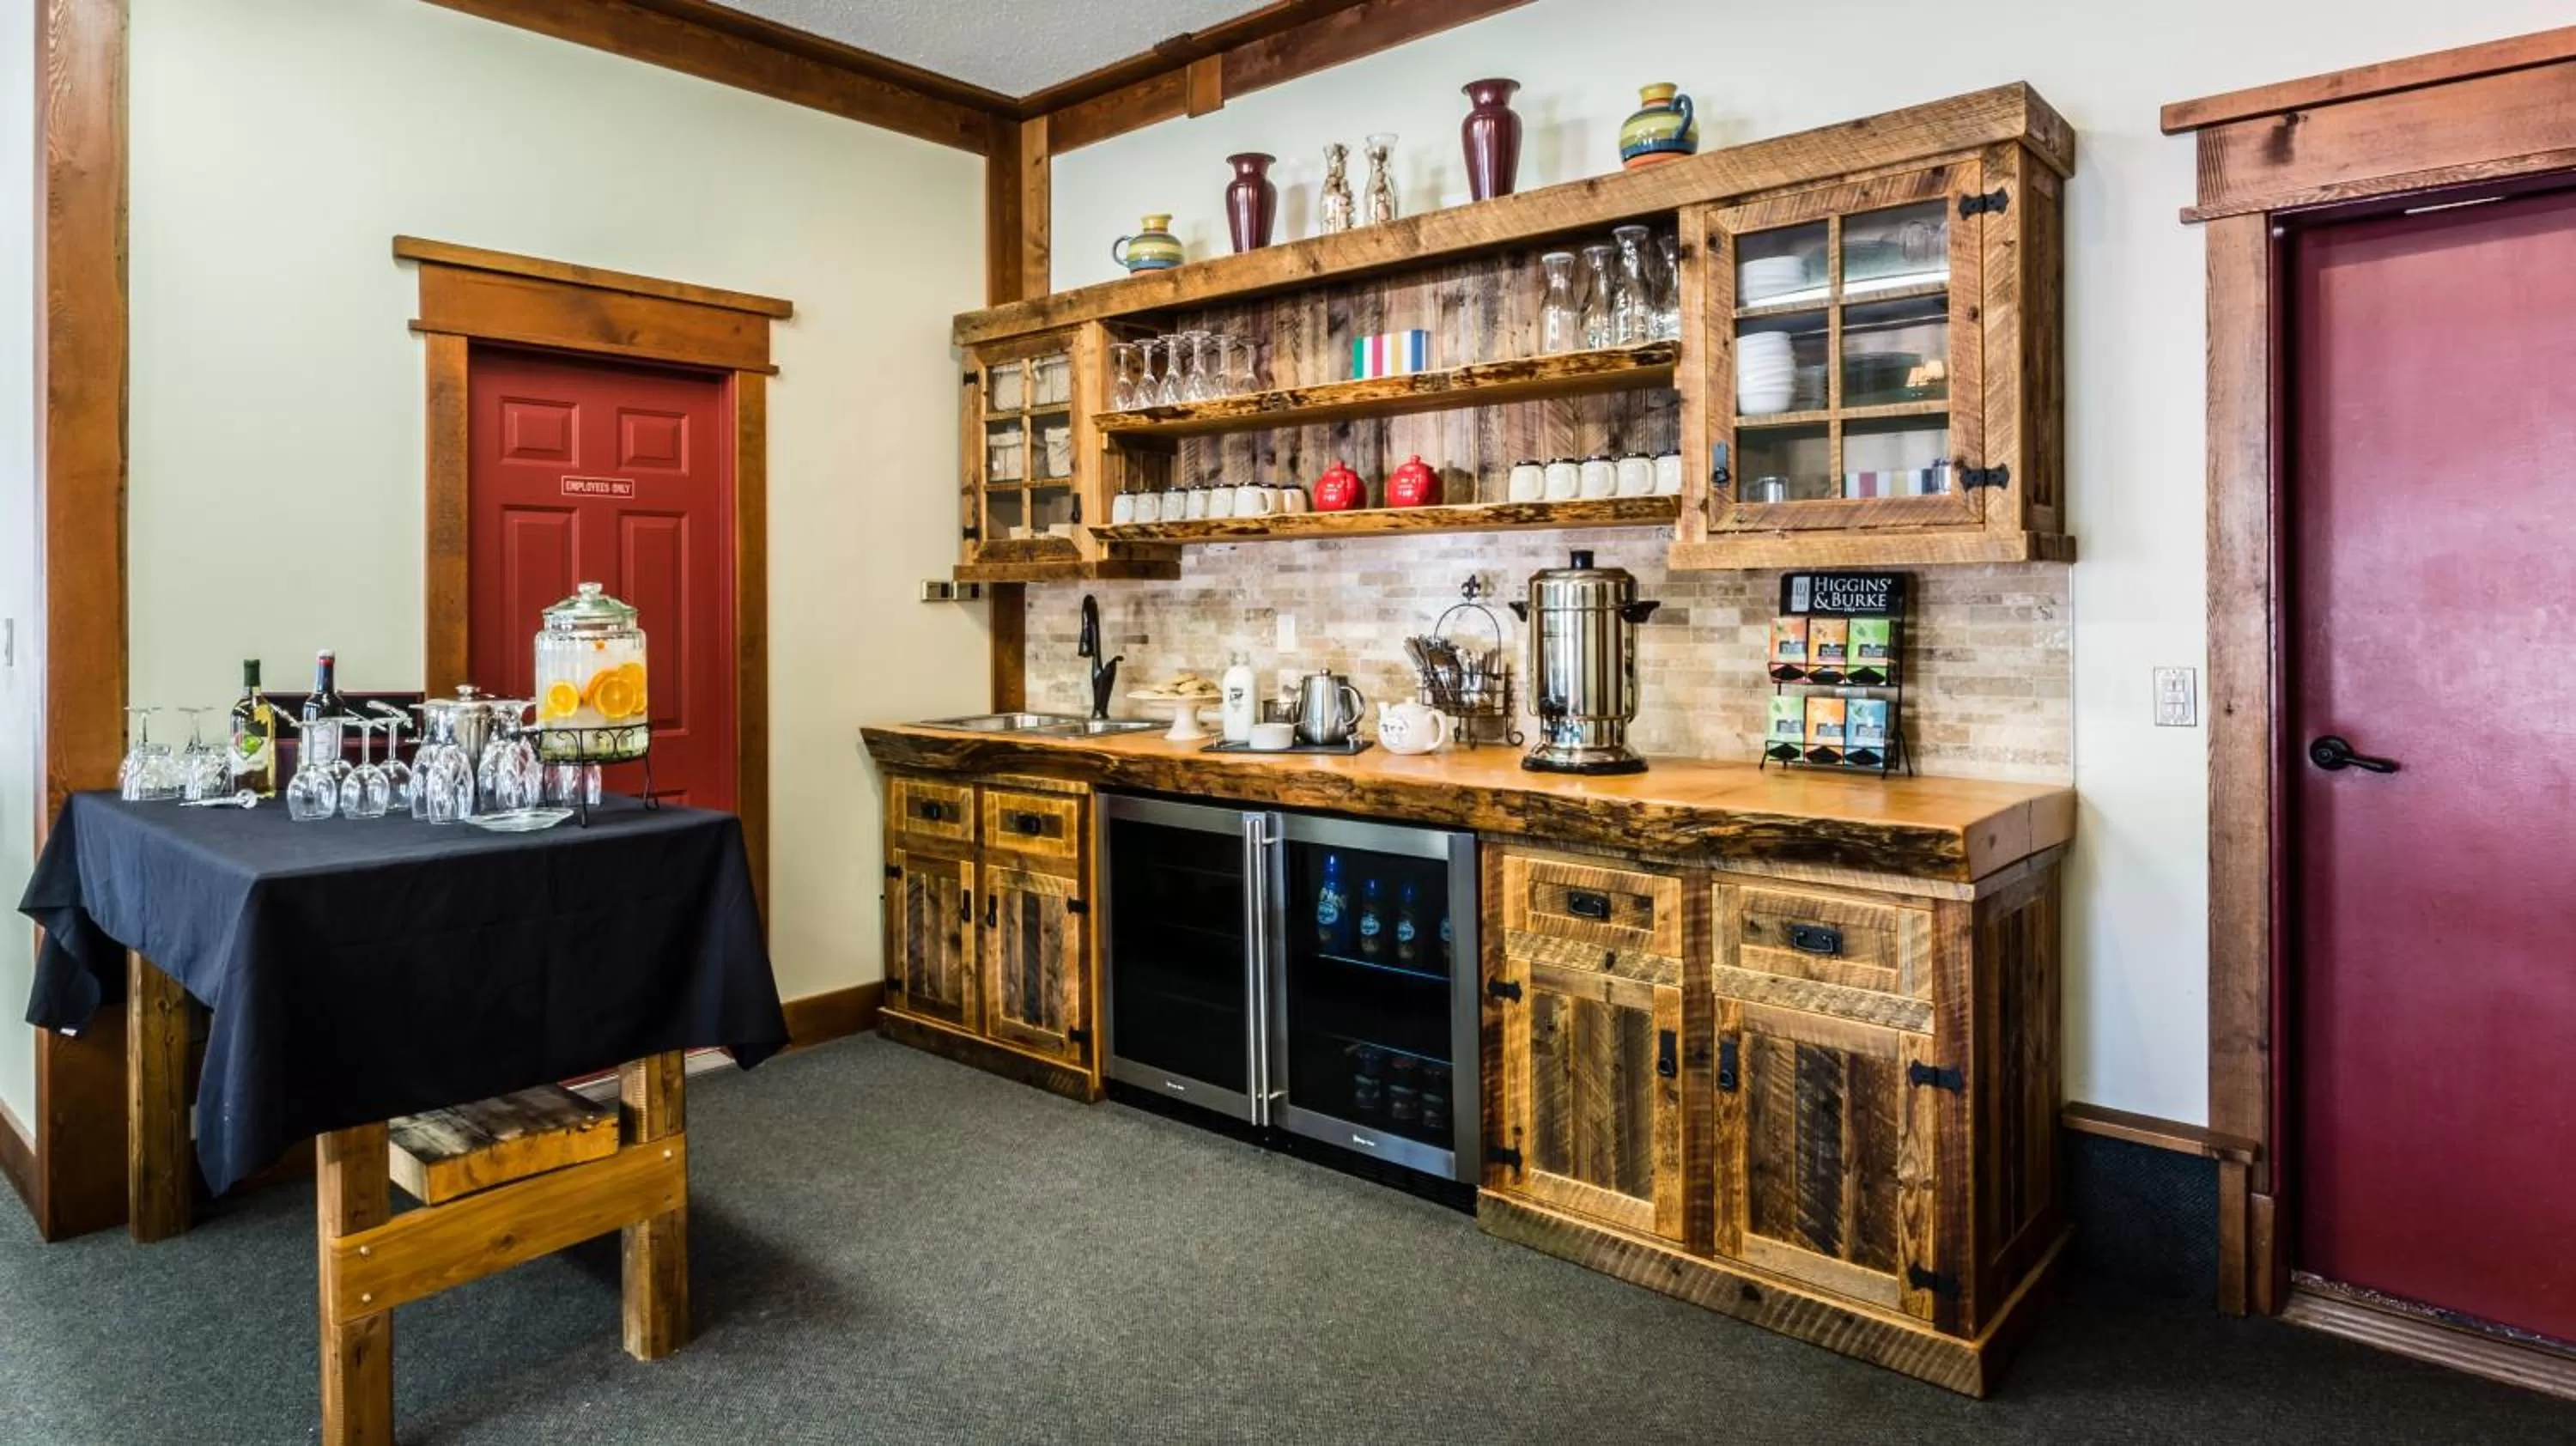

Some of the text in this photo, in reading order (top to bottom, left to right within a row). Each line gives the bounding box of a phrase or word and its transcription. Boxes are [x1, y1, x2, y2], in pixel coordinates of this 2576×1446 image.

[566, 481, 631, 494] EMPLOYEES ONLY
[1814, 592, 1886, 610] & BURKE
